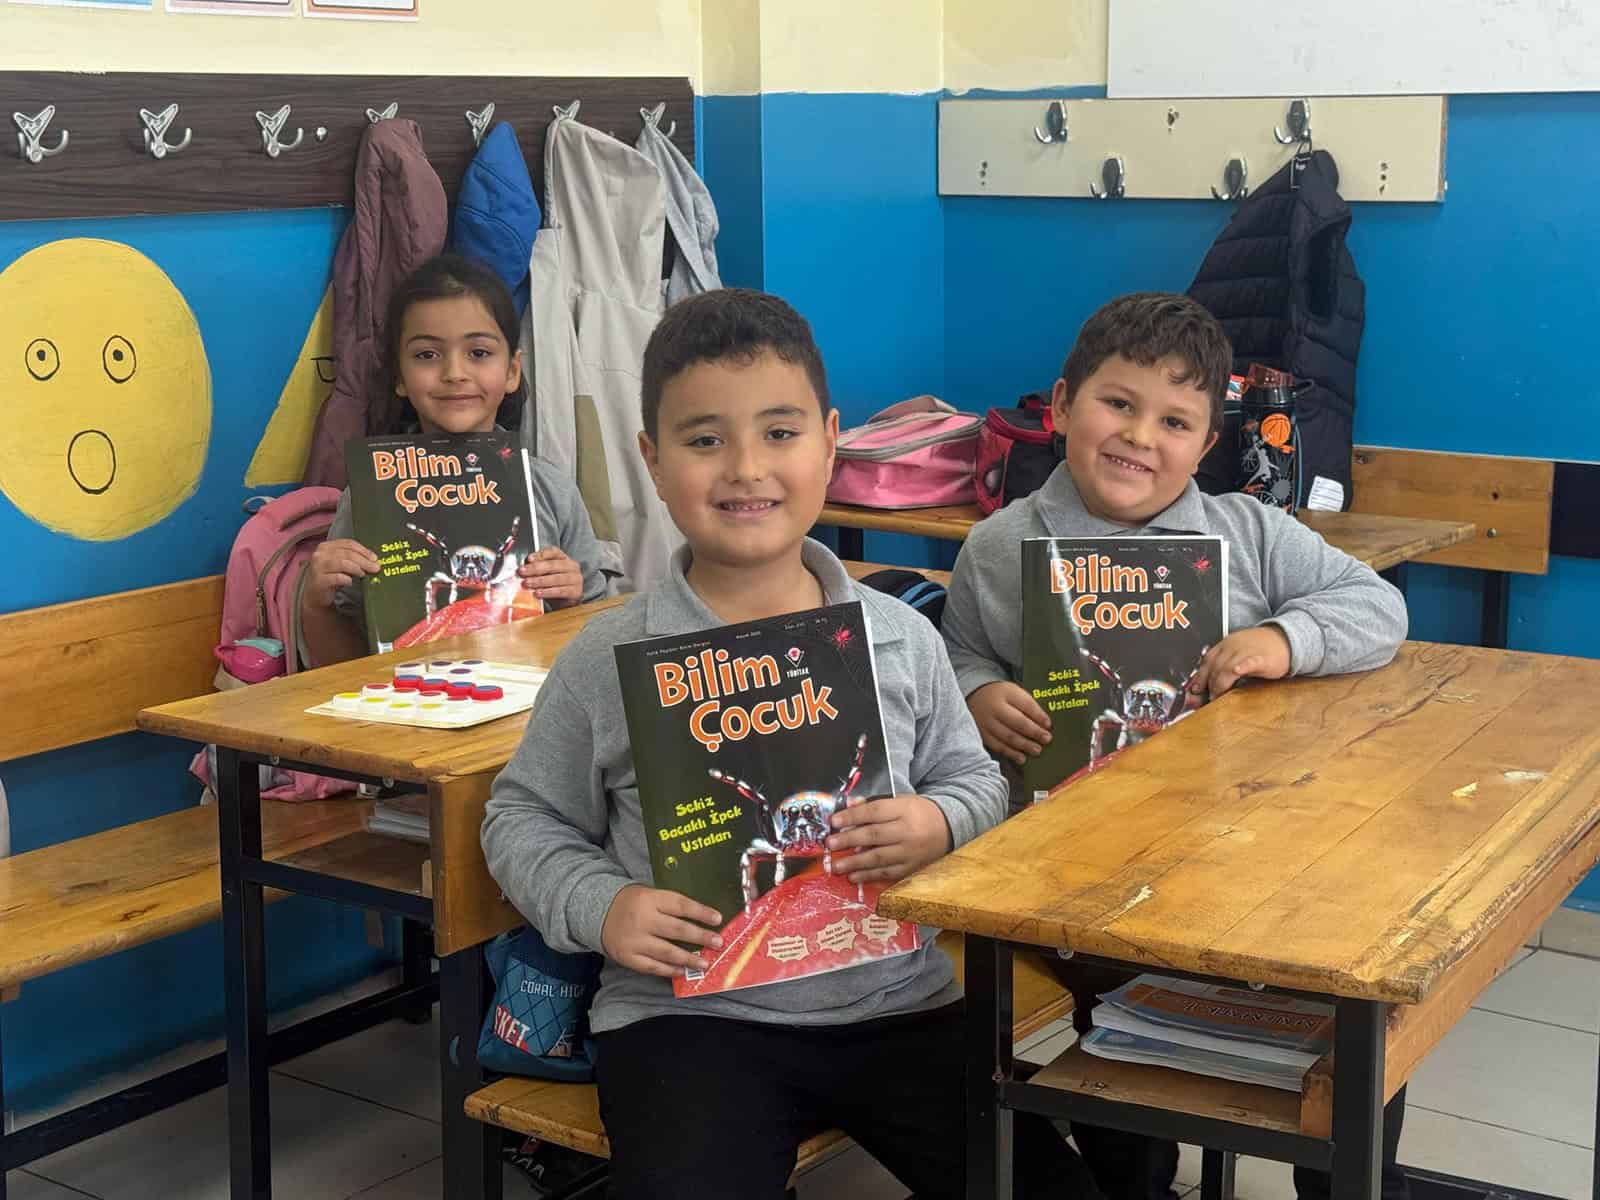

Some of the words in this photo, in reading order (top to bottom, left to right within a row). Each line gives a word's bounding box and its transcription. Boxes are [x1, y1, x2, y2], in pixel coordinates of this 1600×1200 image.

[372, 446, 462, 480] Bilim
[395, 474, 501, 513] Çocuk
[1050, 554, 1148, 593] Bilim
[1071, 592, 1190, 635] Çocuk
[654, 648, 781, 707] Bilim
[1048, 669, 1080, 681] Sekiz
[689, 677, 838, 753] Çocuk
[659, 818, 707, 841] Bacaklı
[709, 805, 742, 825] İpek
[675, 796, 715, 816] Sekiz
[681, 831, 732, 853] Ustaları
[520, 980, 555, 997] CORAL
